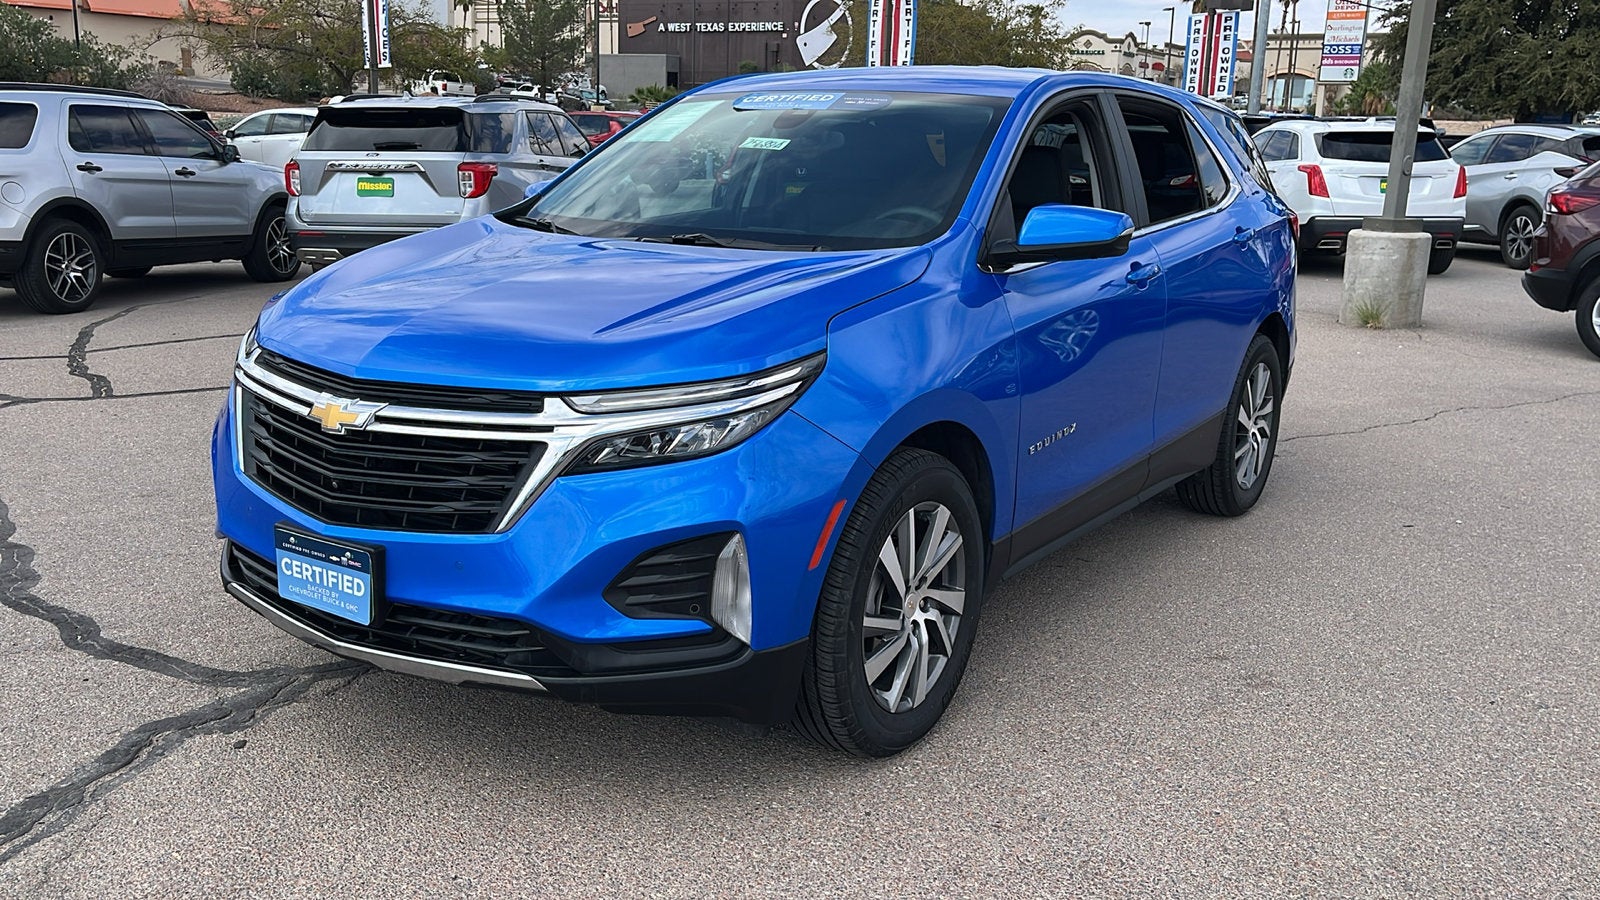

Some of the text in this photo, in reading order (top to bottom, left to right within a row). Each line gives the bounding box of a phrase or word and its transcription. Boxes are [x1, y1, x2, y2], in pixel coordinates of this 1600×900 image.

[658, 23, 665, 31] A
[667, 23, 691, 31] WEST
[696, 23, 724, 31] TEXAS
[1188, 20, 1202, 93] PRE OWNED
[1217, 16, 1233, 92] PRE OWNED
[743, 94, 835, 103] CERTIFIED
[1029, 422, 1077, 455] EQUINOX
[281, 557, 365, 597] CERTIFIED
[307, 584, 339, 599] BACKED BY
[288, 584, 321, 600] CHEVROLET
[322, 595, 340, 606] BUICK
[345, 603, 359, 613] GMC
